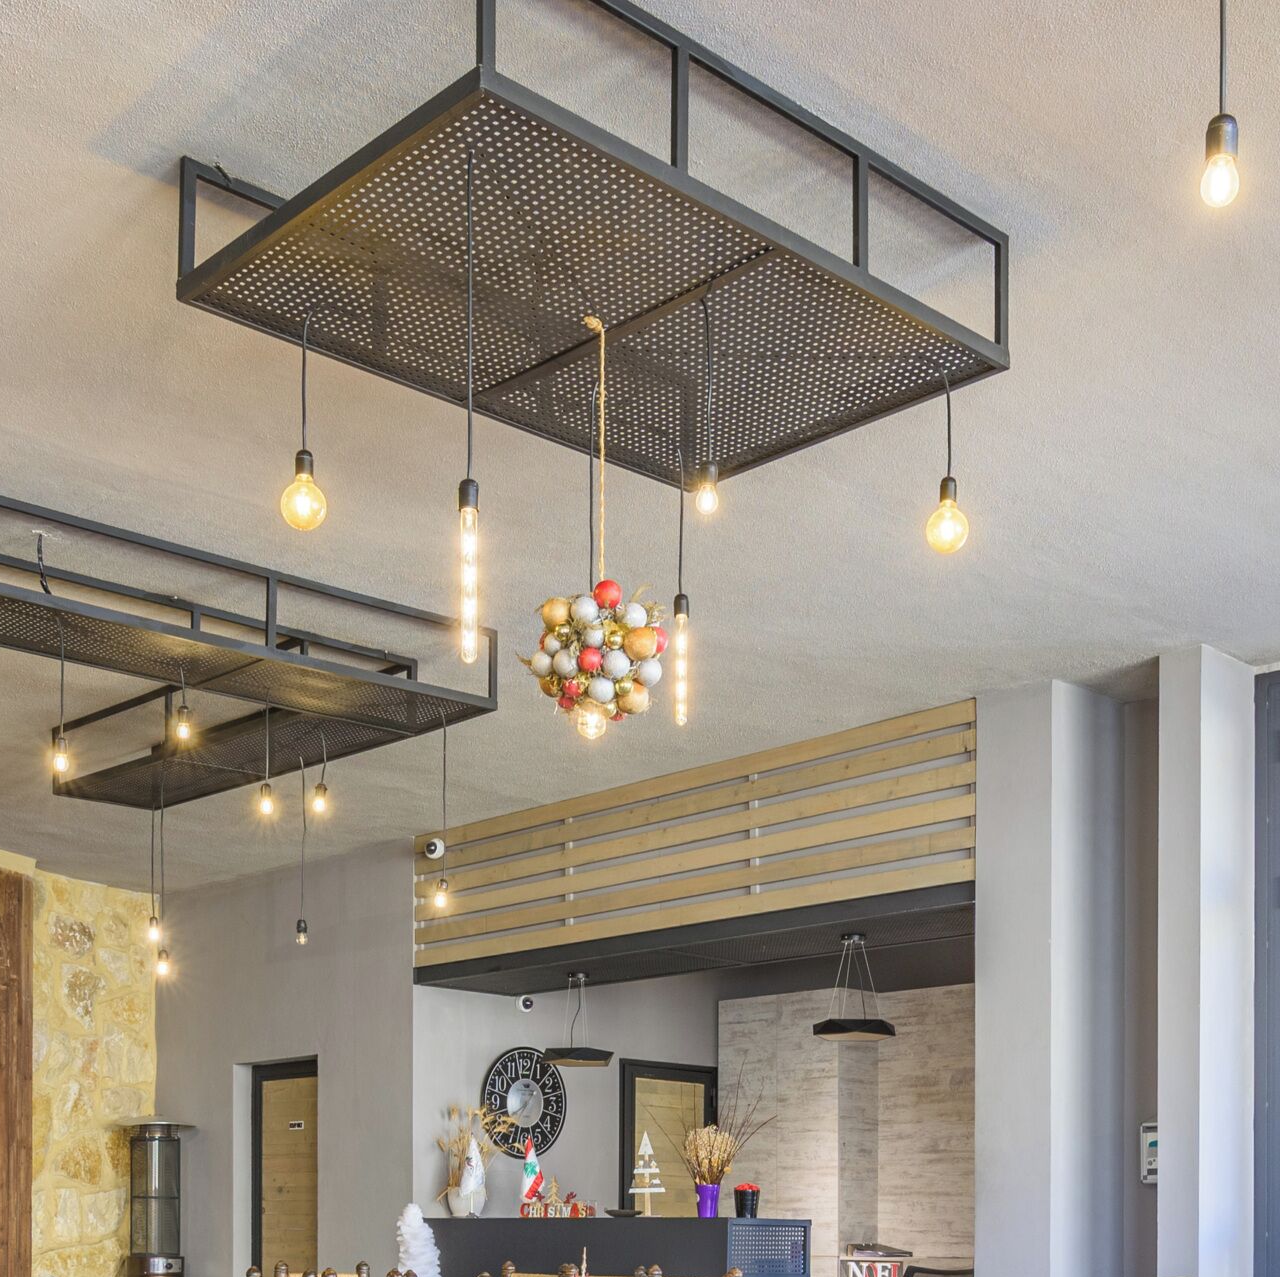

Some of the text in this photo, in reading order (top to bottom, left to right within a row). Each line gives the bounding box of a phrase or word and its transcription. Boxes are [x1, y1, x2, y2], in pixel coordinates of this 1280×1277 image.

[508, 1062, 516, 1077] 11
[519, 1058, 531, 1075] 12
[536, 1064, 541, 1079] 1
[495, 1075, 507, 1092] 10
[545, 1077, 553, 1092] 2
[492, 1094, 500, 1109] 9
[549, 1097, 557, 1112] 3
[544, 1116, 551, 1131] 4
[534, 1129, 542, 1144] 5
[520, 1202, 586, 1218] CHRISTMAS
